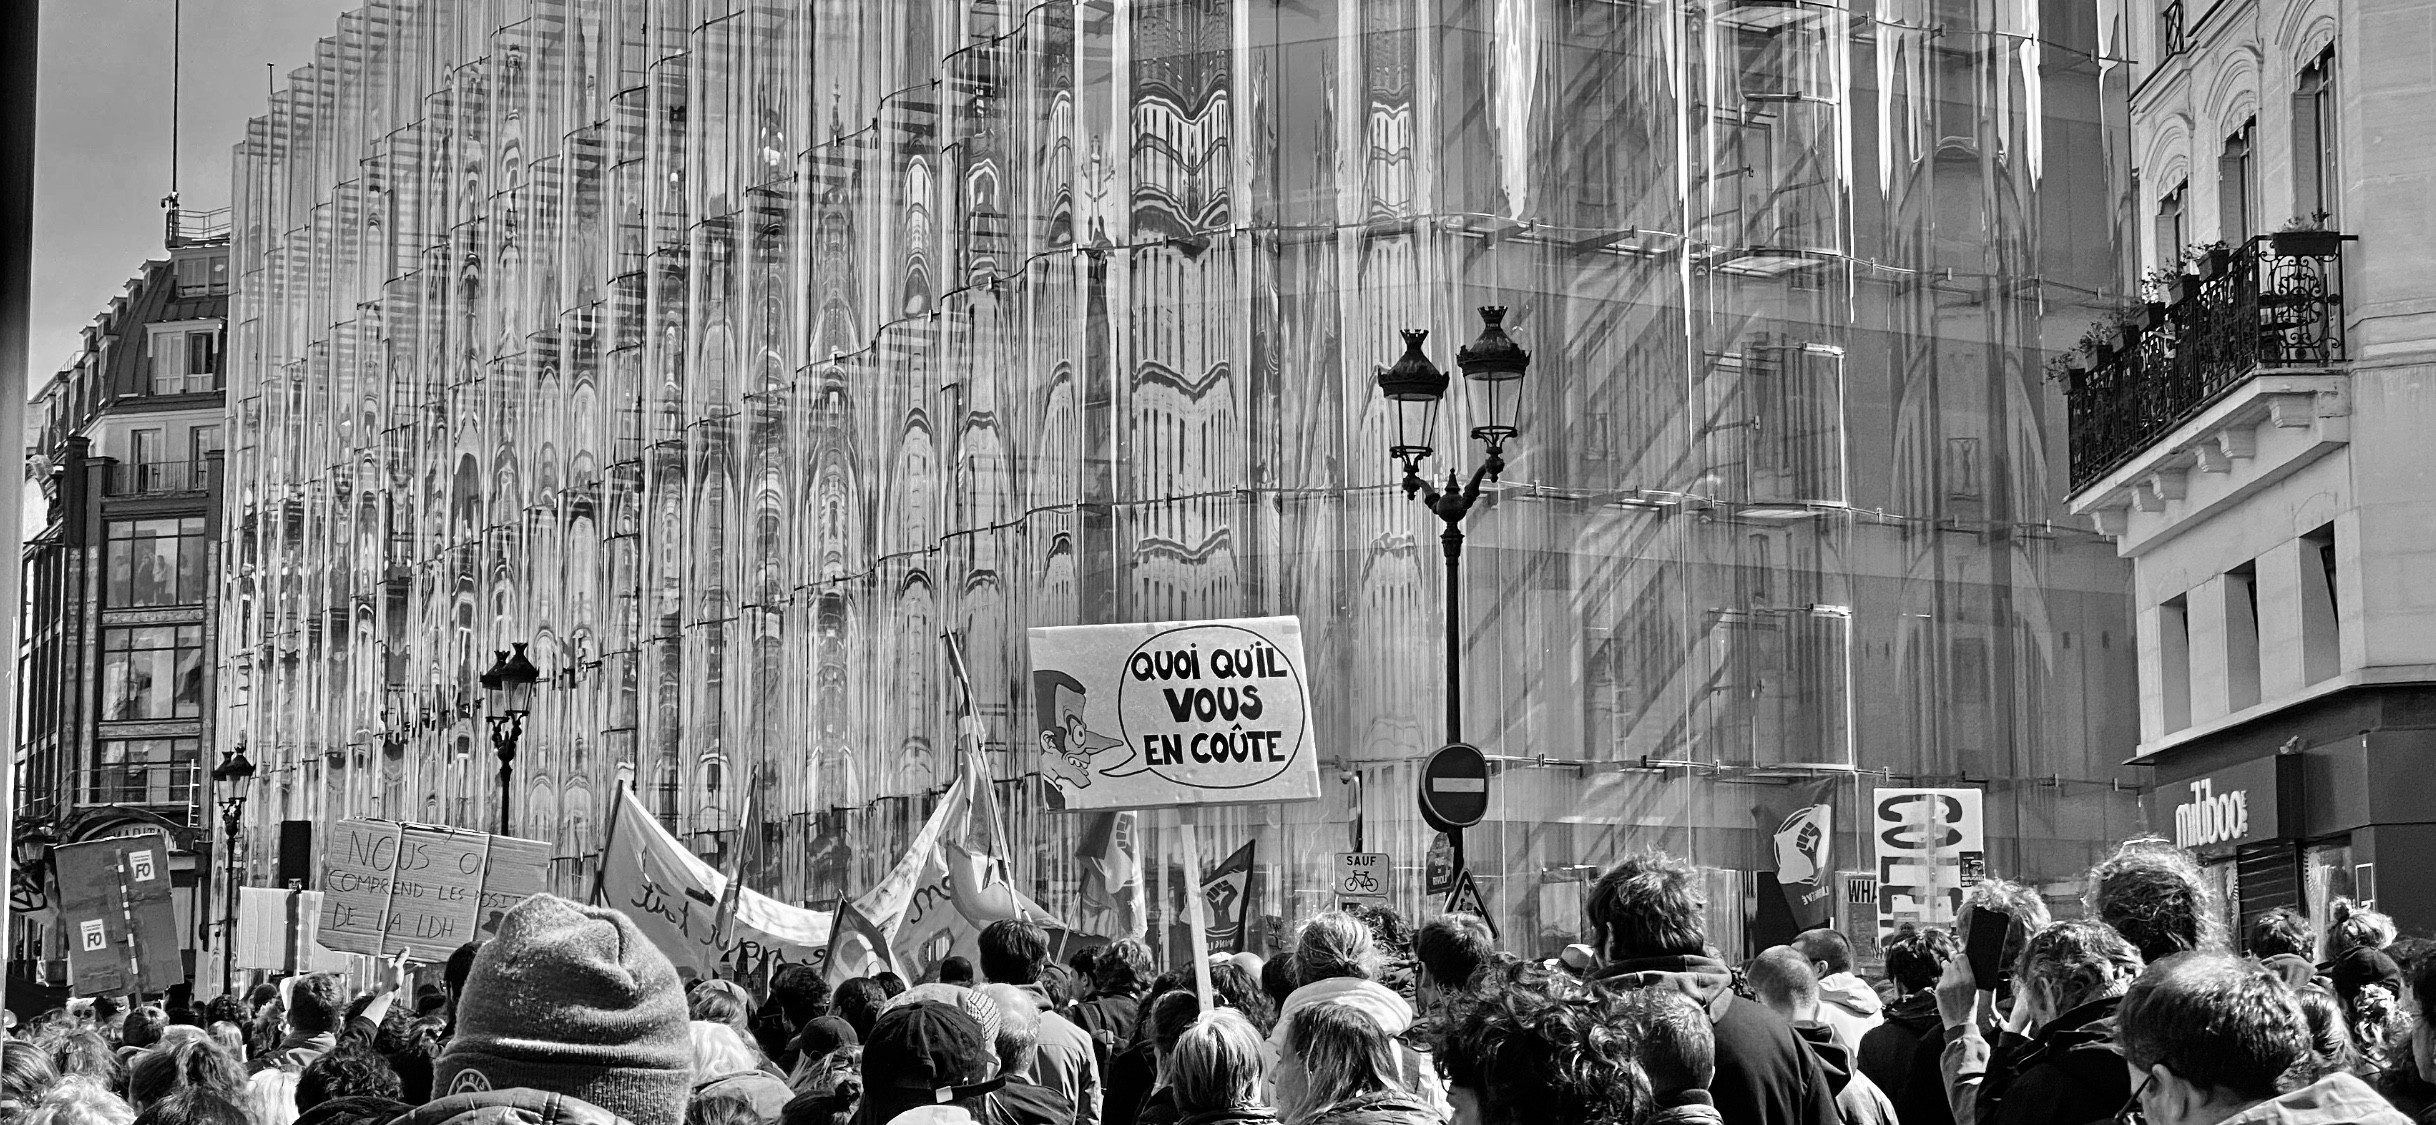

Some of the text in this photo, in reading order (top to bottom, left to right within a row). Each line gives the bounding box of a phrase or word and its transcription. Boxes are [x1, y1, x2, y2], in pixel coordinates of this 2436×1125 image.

[1162, 685, 1263, 723] VOUS
[1143, 722, 1286, 765] EN COÛTE
[2175, 778, 2241, 850] miliboo
[347, 831, 430, 871] NOUS
[1346, 855, 1377, 867] SAUF
[135, 862, 151, 879] FO
[328, 869, 423, 898] COMPREND
[438, 885, 466, 901] LES
[332, 902, 455, 939] DE LA LDH
[87, 931, 103, 948] FO
